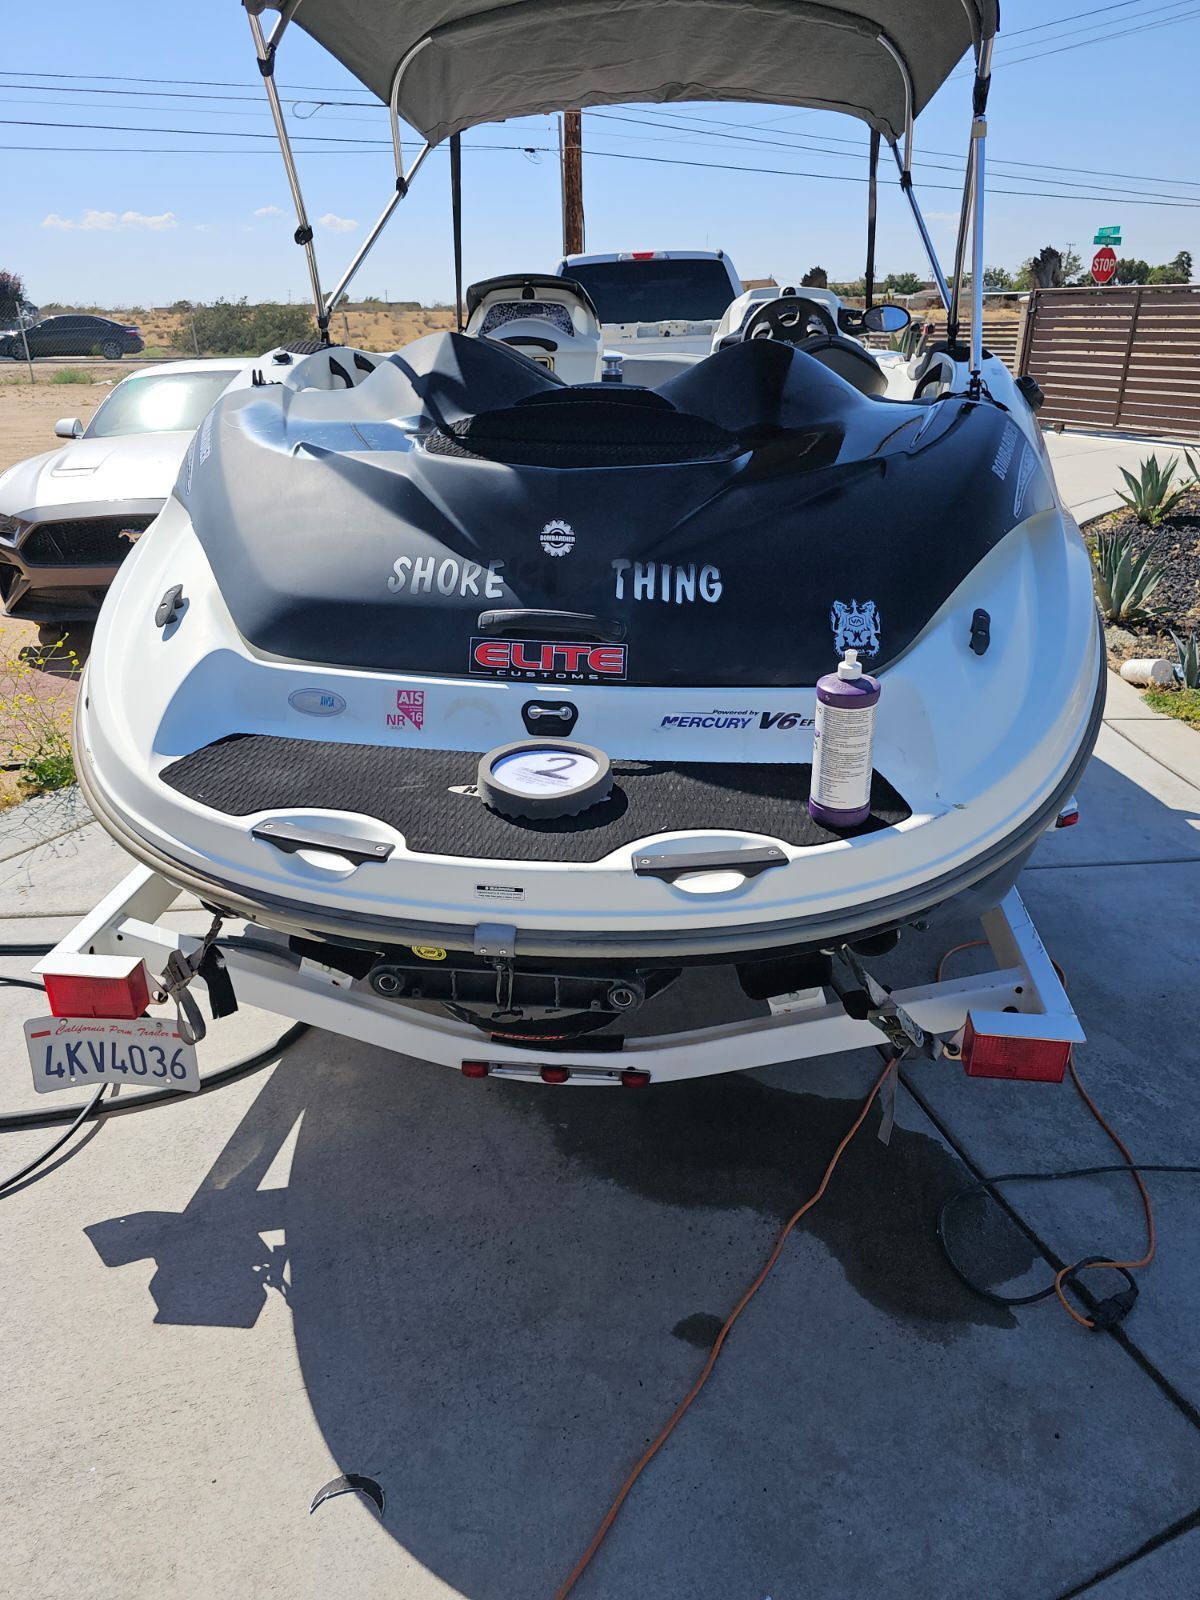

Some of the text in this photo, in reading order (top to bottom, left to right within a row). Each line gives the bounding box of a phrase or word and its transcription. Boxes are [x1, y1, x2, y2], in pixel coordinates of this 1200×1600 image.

[1092, 258, 1115, 272] STOP
[387, 556, 723, 604] SHORE THING
[474, 641, 624, 674] ELITE
[496, 669, 599, 680] CUSTOMS
[398, 691, 423, 705] AIS
[386, 714, 406, 726] NR
[410, 711, 423, 722] 16
[661, 711, 816, 730] MERCURY V6 EF
[533, 757, 578, 780] 2
[55, 1024, 170, 1038] California Perm Trailer
